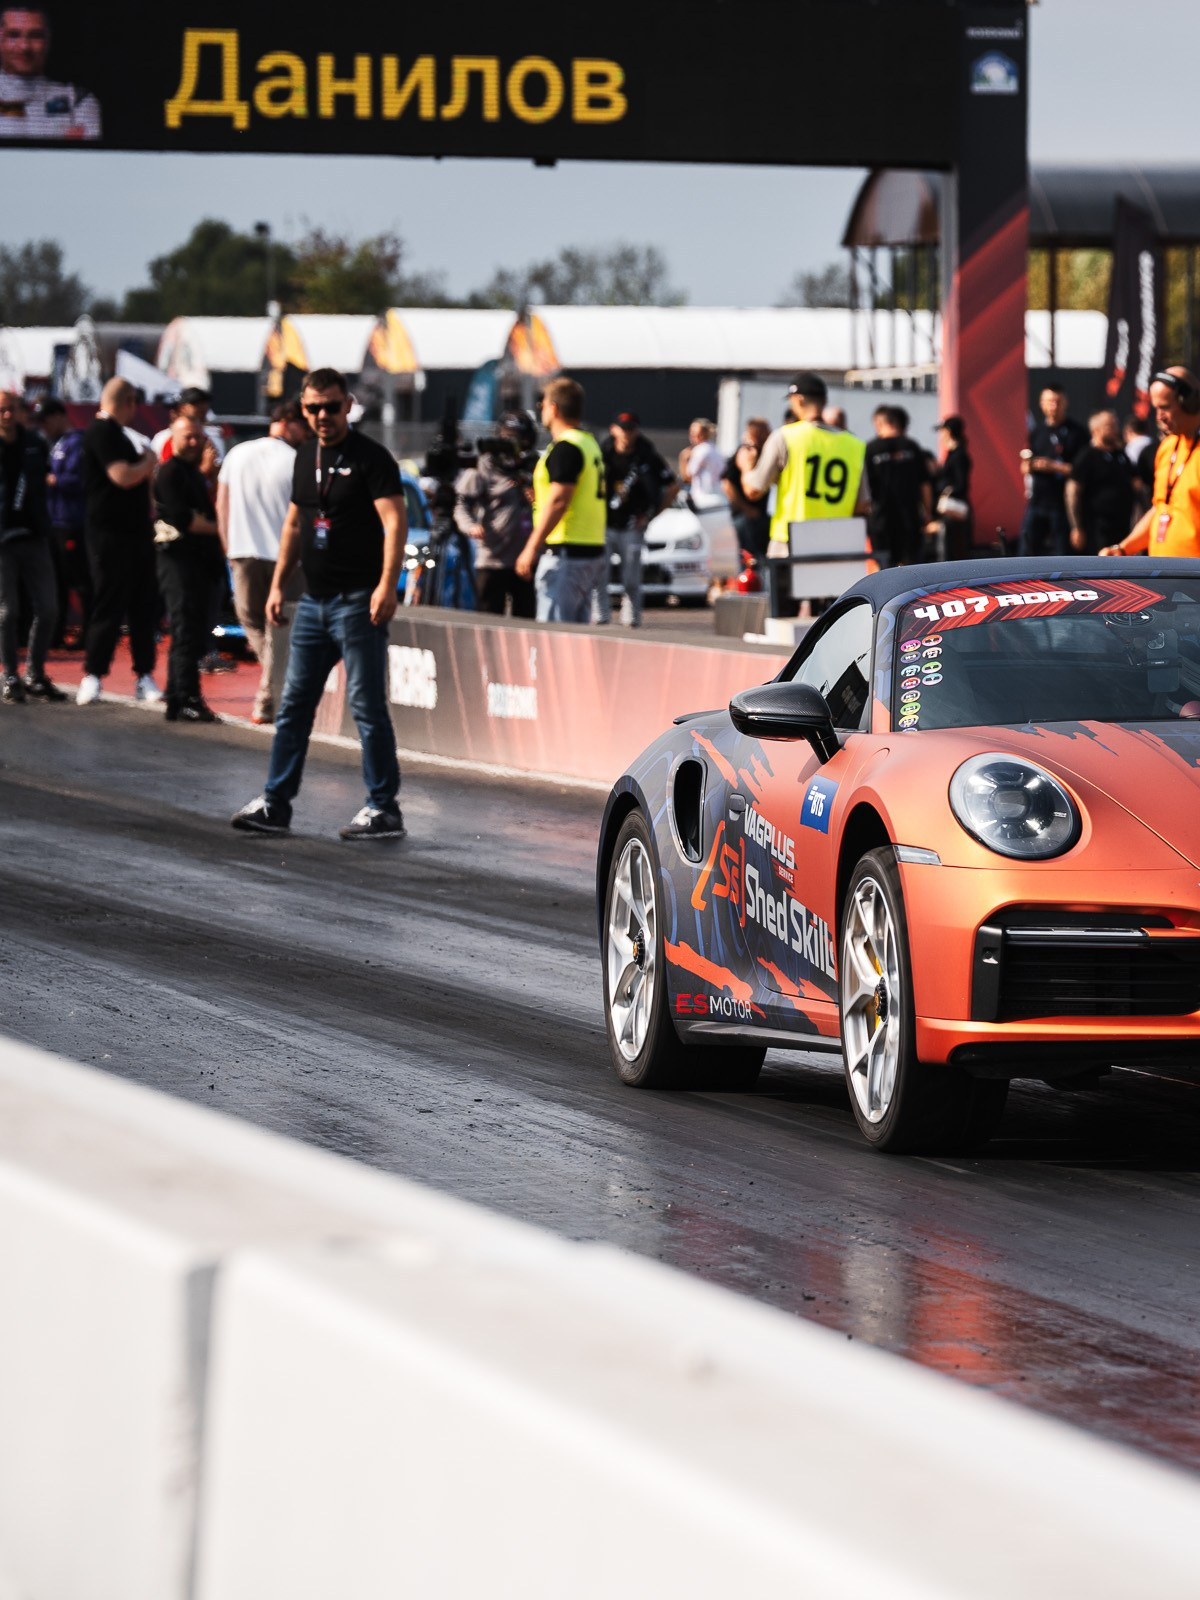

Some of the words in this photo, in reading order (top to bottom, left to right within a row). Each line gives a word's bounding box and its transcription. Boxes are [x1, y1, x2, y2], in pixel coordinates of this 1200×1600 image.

[165, 28, 628, 130] Данилов
[805, 453, 849, 504] 19
[913, 595, 990, 622] 407
[995, 589, 1099, 607] RDRC
[810, 791, 827, 817] ВТБ
[744, 803, 796, 870] VAGPLUS
[778, 865, 794, 884] SERVICE
[745, 862, 789, 945] Shed
[675, 993, 708, 1015] ES
[709, 995, 753, 1020] MOTOR
